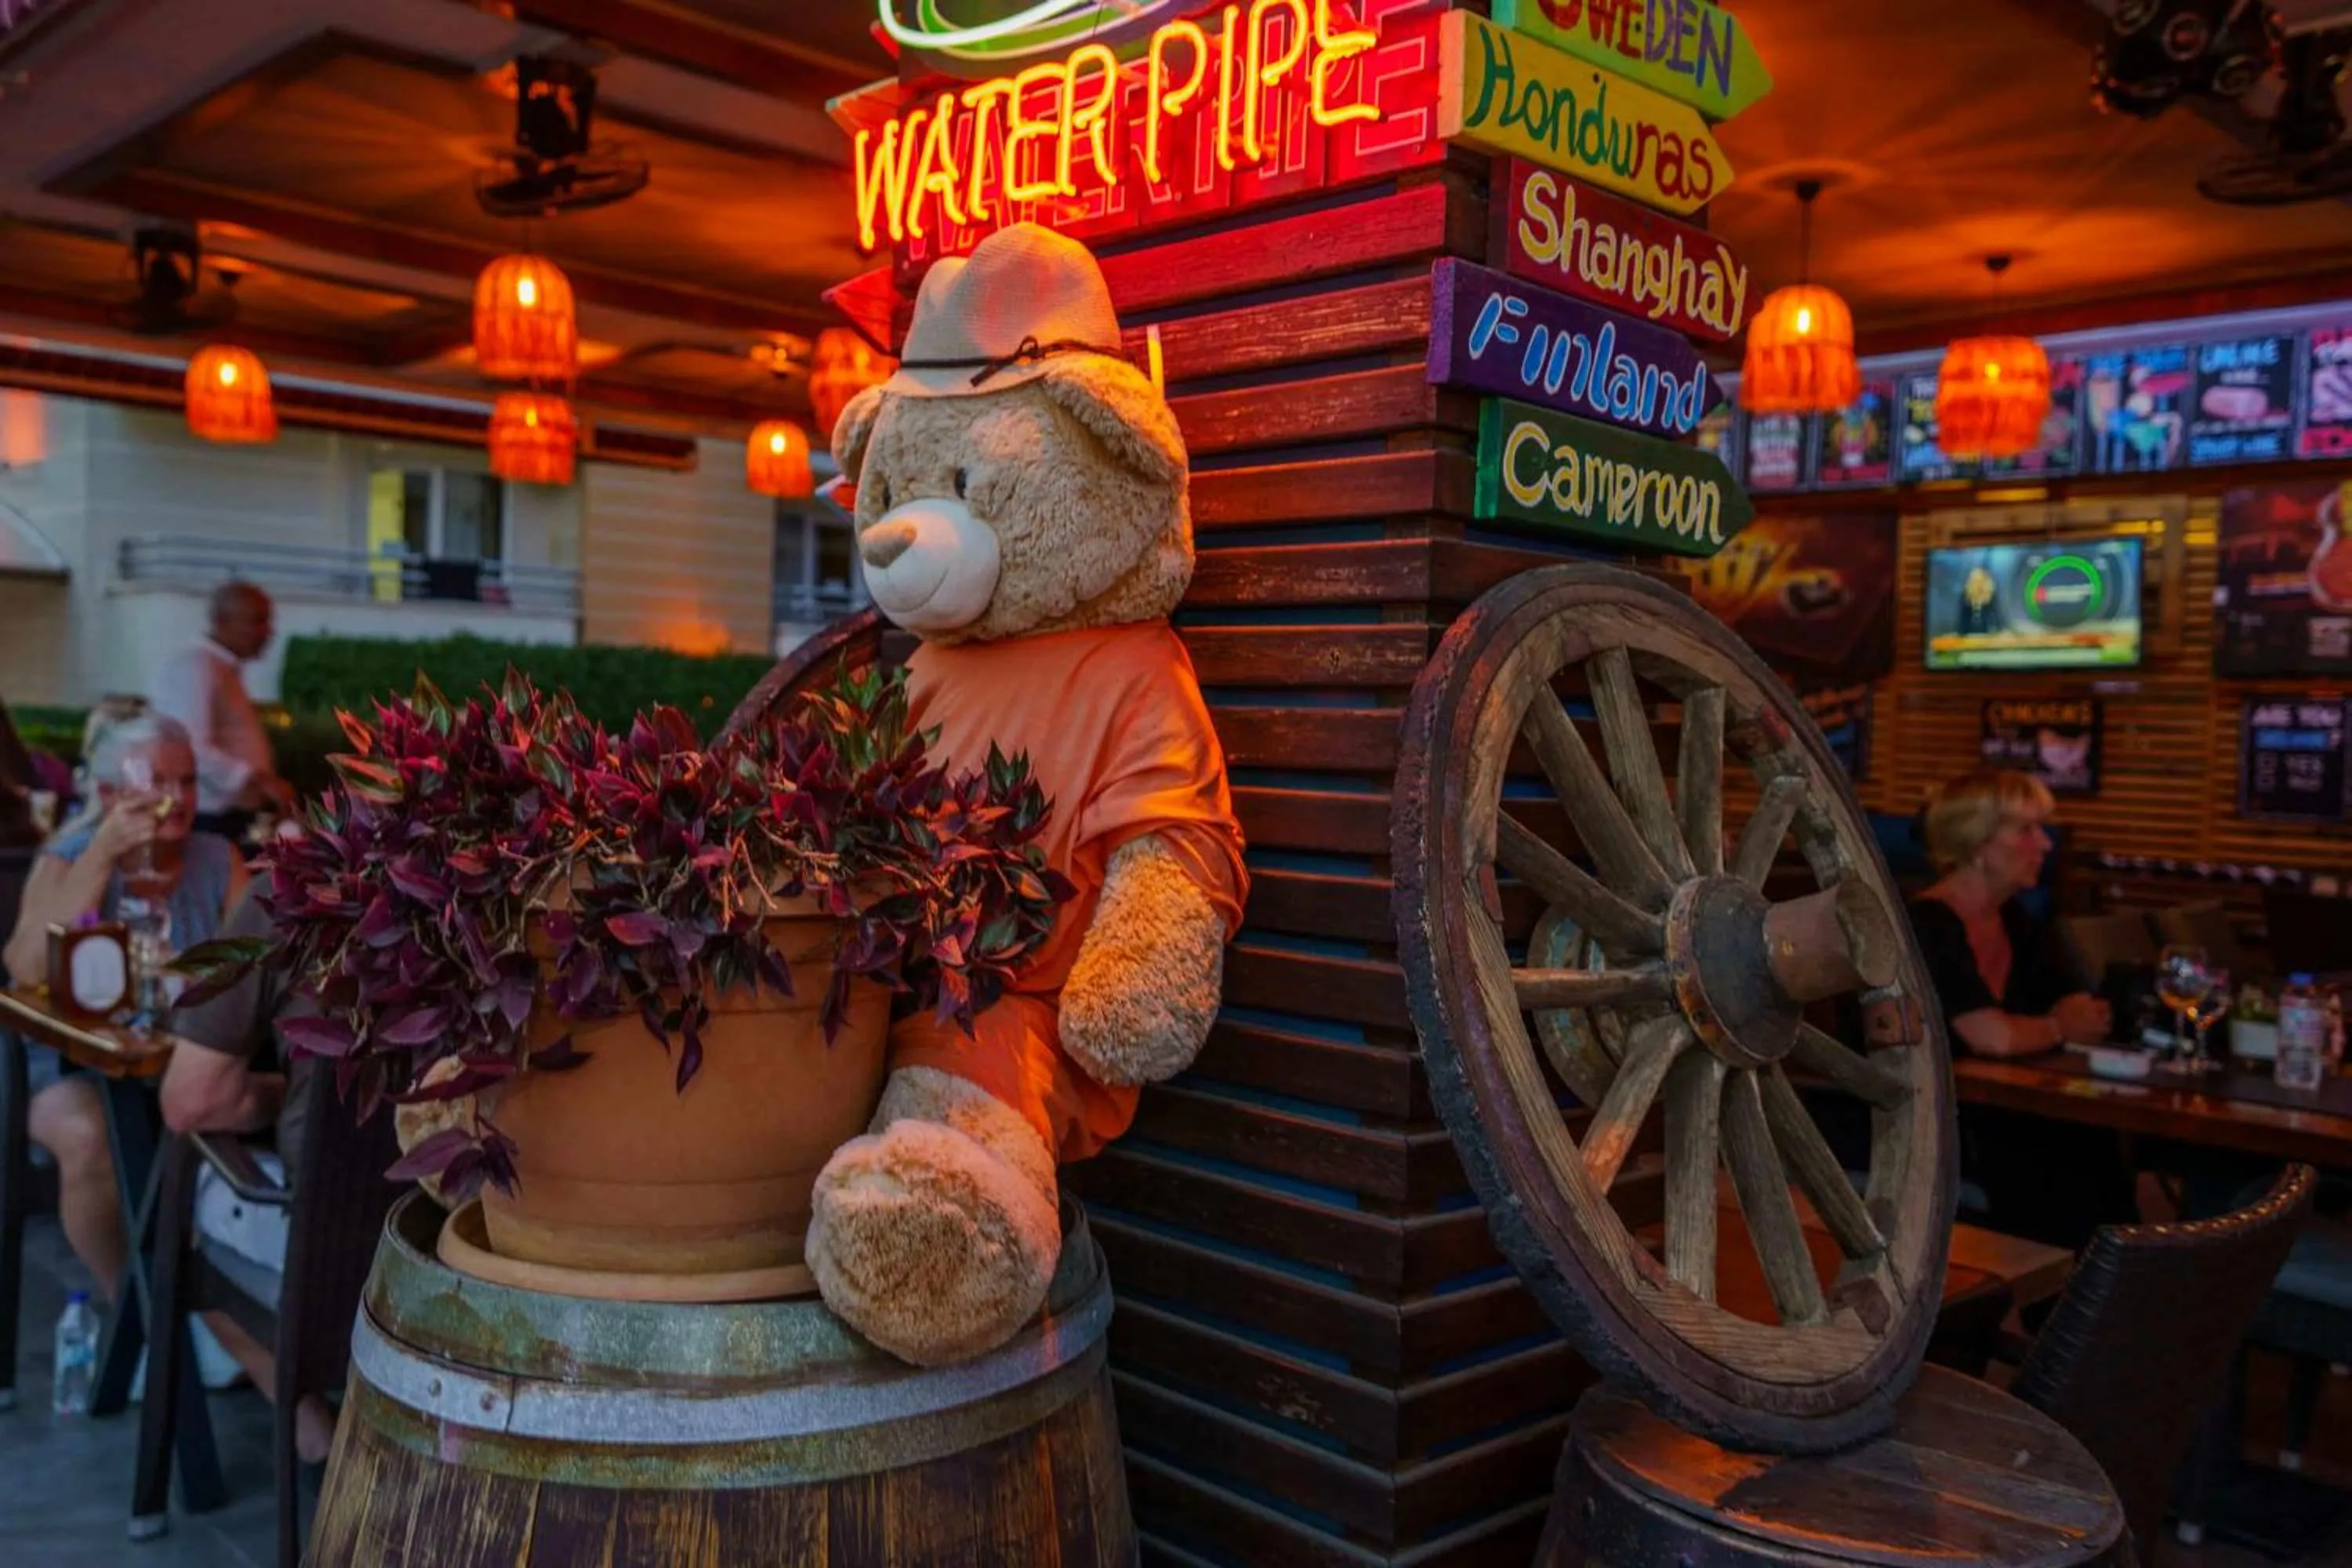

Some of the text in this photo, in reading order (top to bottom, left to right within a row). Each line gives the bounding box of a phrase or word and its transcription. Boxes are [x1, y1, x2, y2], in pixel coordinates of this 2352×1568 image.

[855, 0, 1381, 250] WATER PIPE
[1465, 23, 1715, 201] Honduras
[1519, 170, 1748, 337] Shanghay
[1468, 292, 1707, 434] Finland
[1503, 421, 1726, 545] Cameroon
